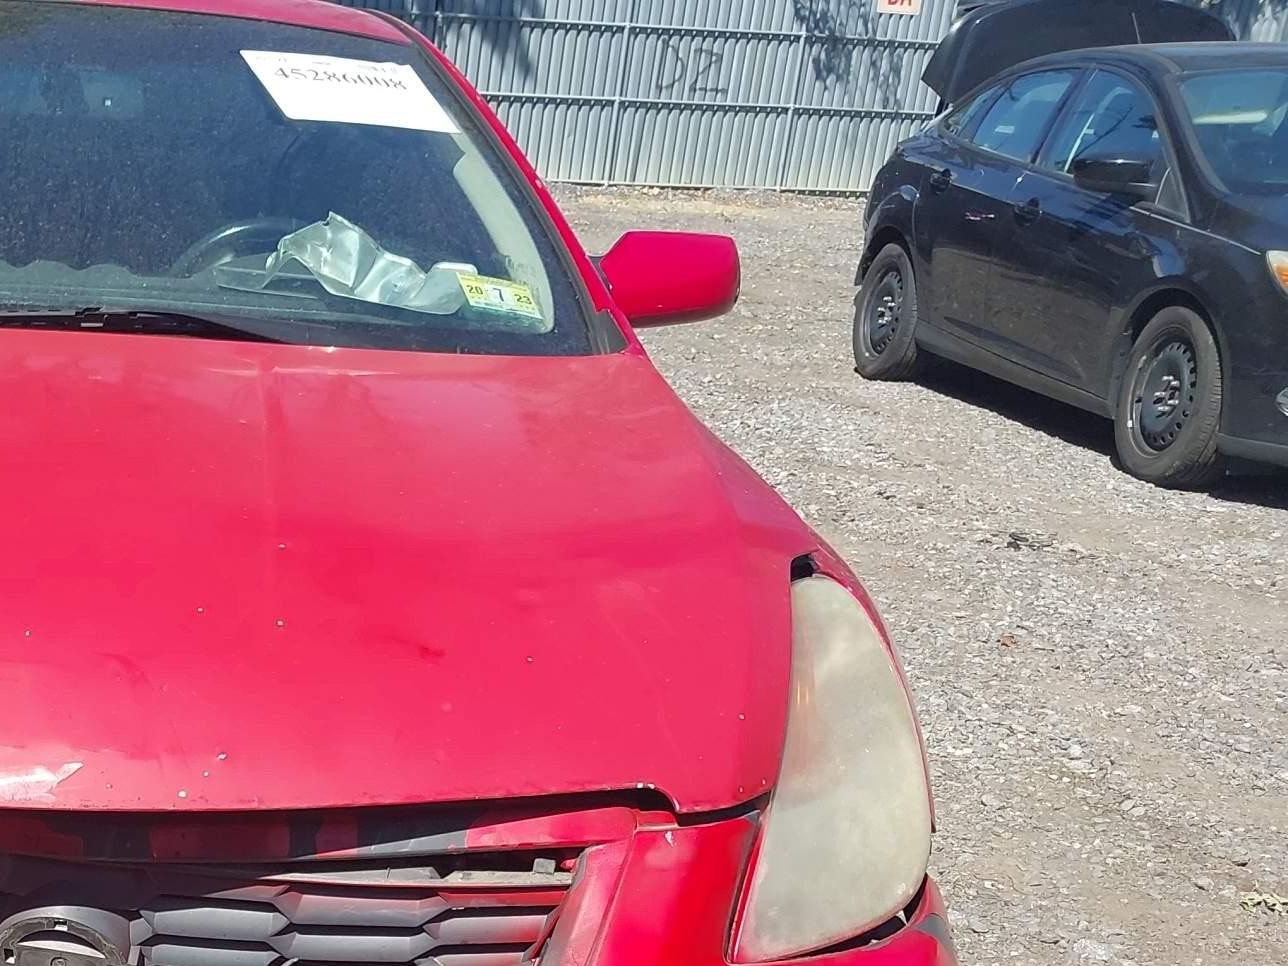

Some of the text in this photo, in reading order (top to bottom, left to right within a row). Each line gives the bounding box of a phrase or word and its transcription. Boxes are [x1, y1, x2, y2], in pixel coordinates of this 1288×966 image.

[274, 67, 408, 90] 45286008
[466, 284, 533, 305] 20 7 23
